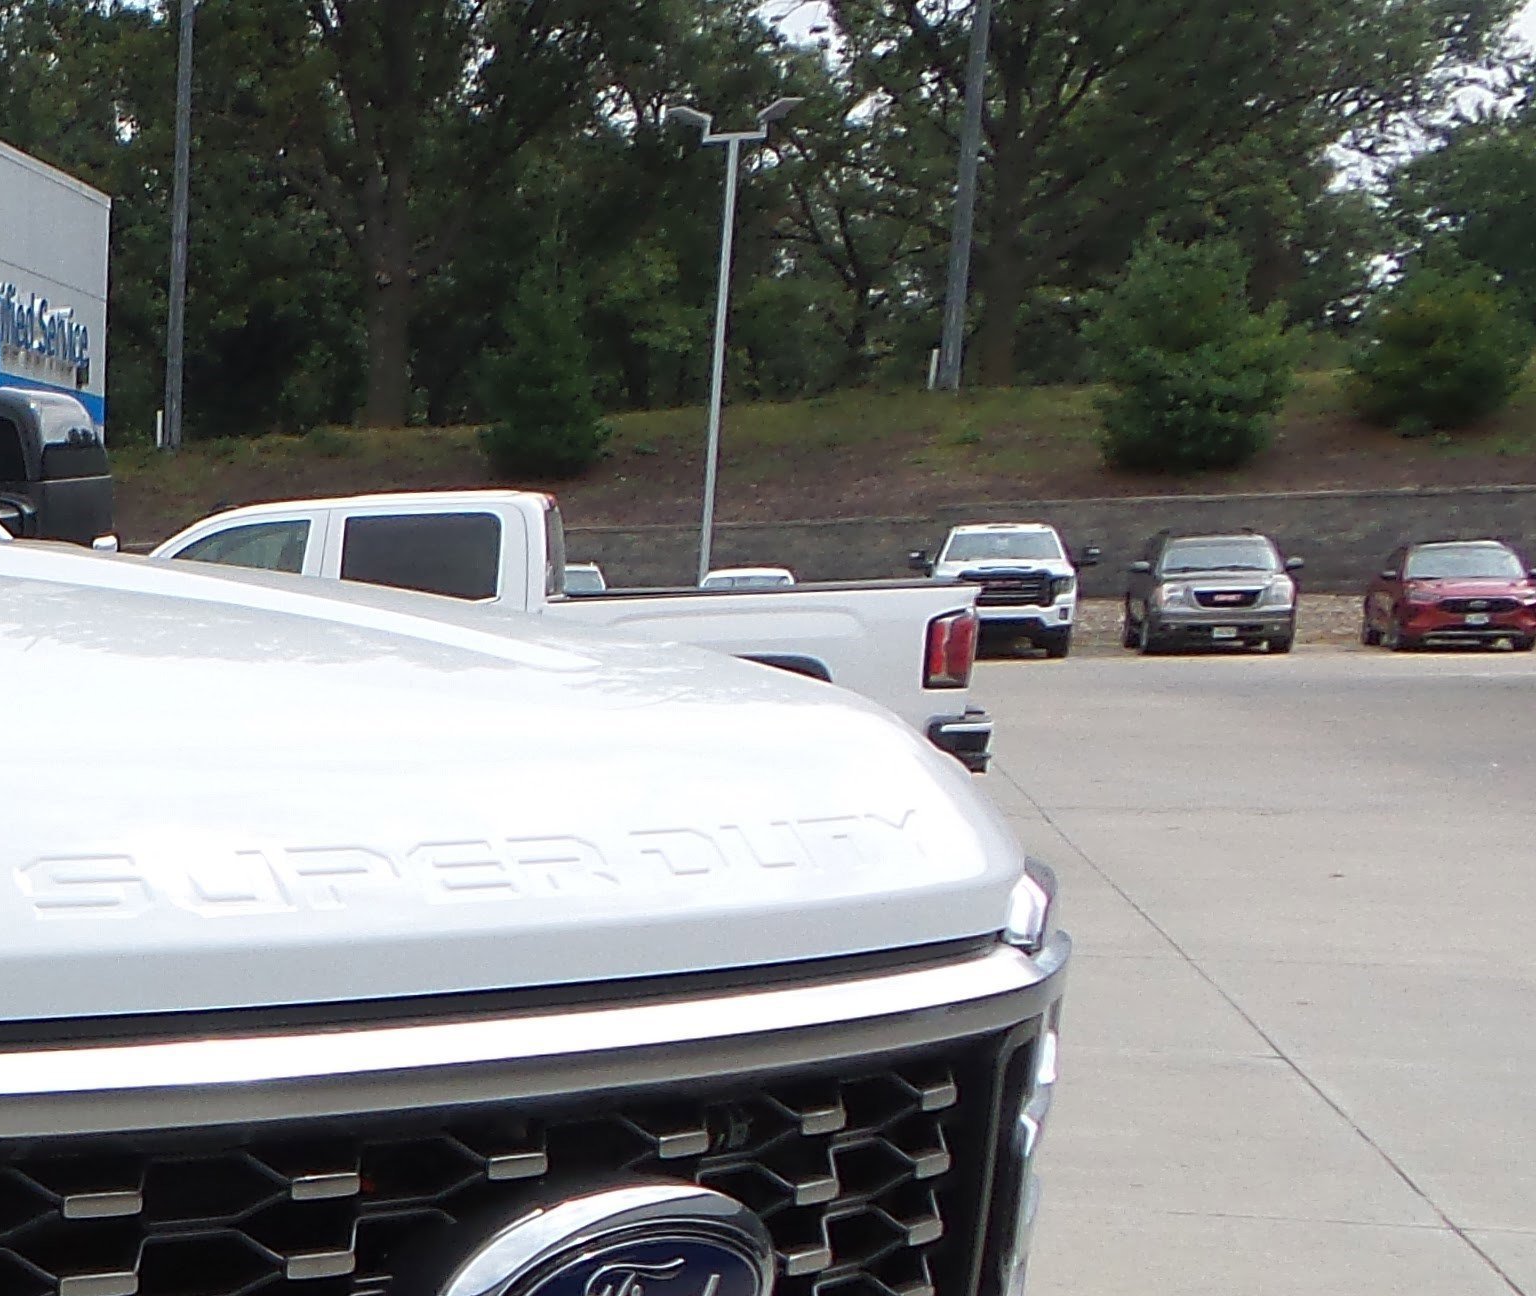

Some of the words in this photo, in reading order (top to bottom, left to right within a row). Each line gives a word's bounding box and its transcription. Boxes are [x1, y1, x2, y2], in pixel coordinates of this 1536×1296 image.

[39, 298, 90, 368] Service
[11, 836, 622, 920] SUPER
[626, 808, 931, 892] DUTY
